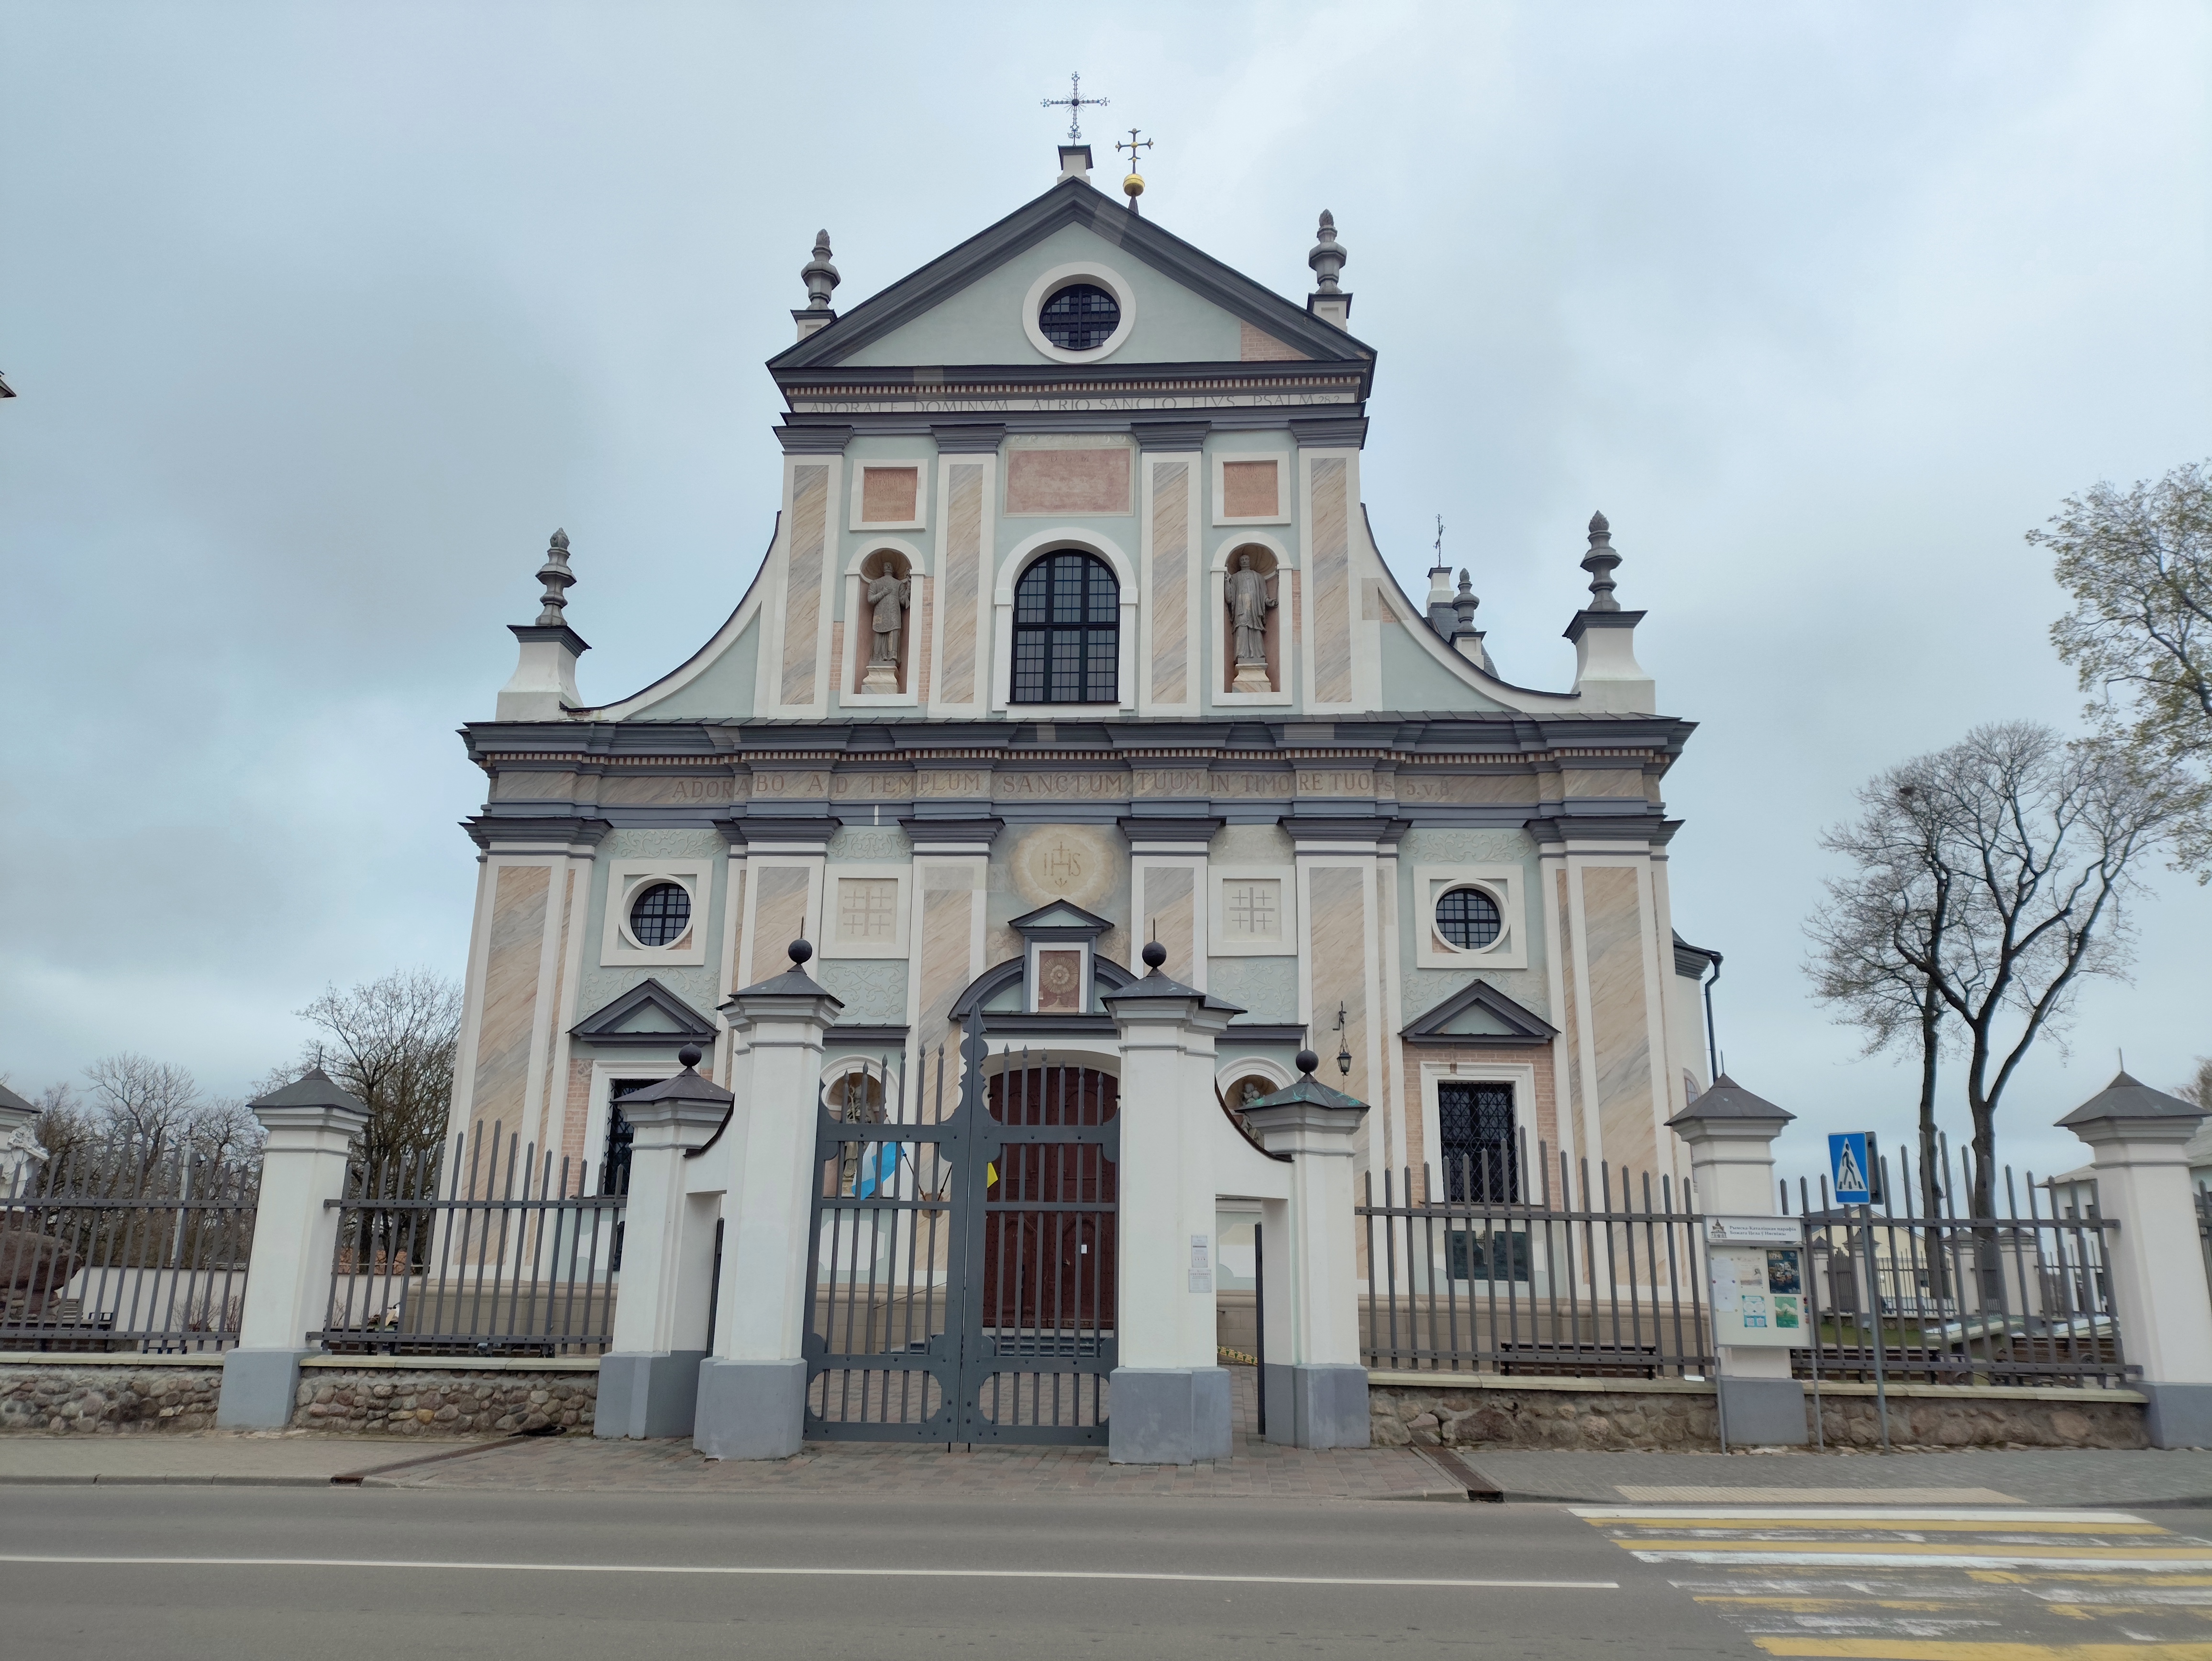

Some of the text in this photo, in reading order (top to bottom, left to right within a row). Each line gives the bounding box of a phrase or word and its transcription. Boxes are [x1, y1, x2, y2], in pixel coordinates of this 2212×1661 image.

[810, 401, 897, 412] ADORATE
[913, 400, 1009, 412] DOMINVM
[1032, 399, 1090, 411] ATRIO
[1099, 398, 1177, 410] SANCTO
[672, 775, 785, 798] ADORABO
[865, 773, 981, 793] TEMPLUM
[1003, 775, 1123, 793] SANCTUM
[1136, 772, 1201, 790] TUUM
[1210, 774, 1230, 792] IN
[1240, 773, 1324, 792] TIMORE
[1329, 773, 1370, 790] TUO
